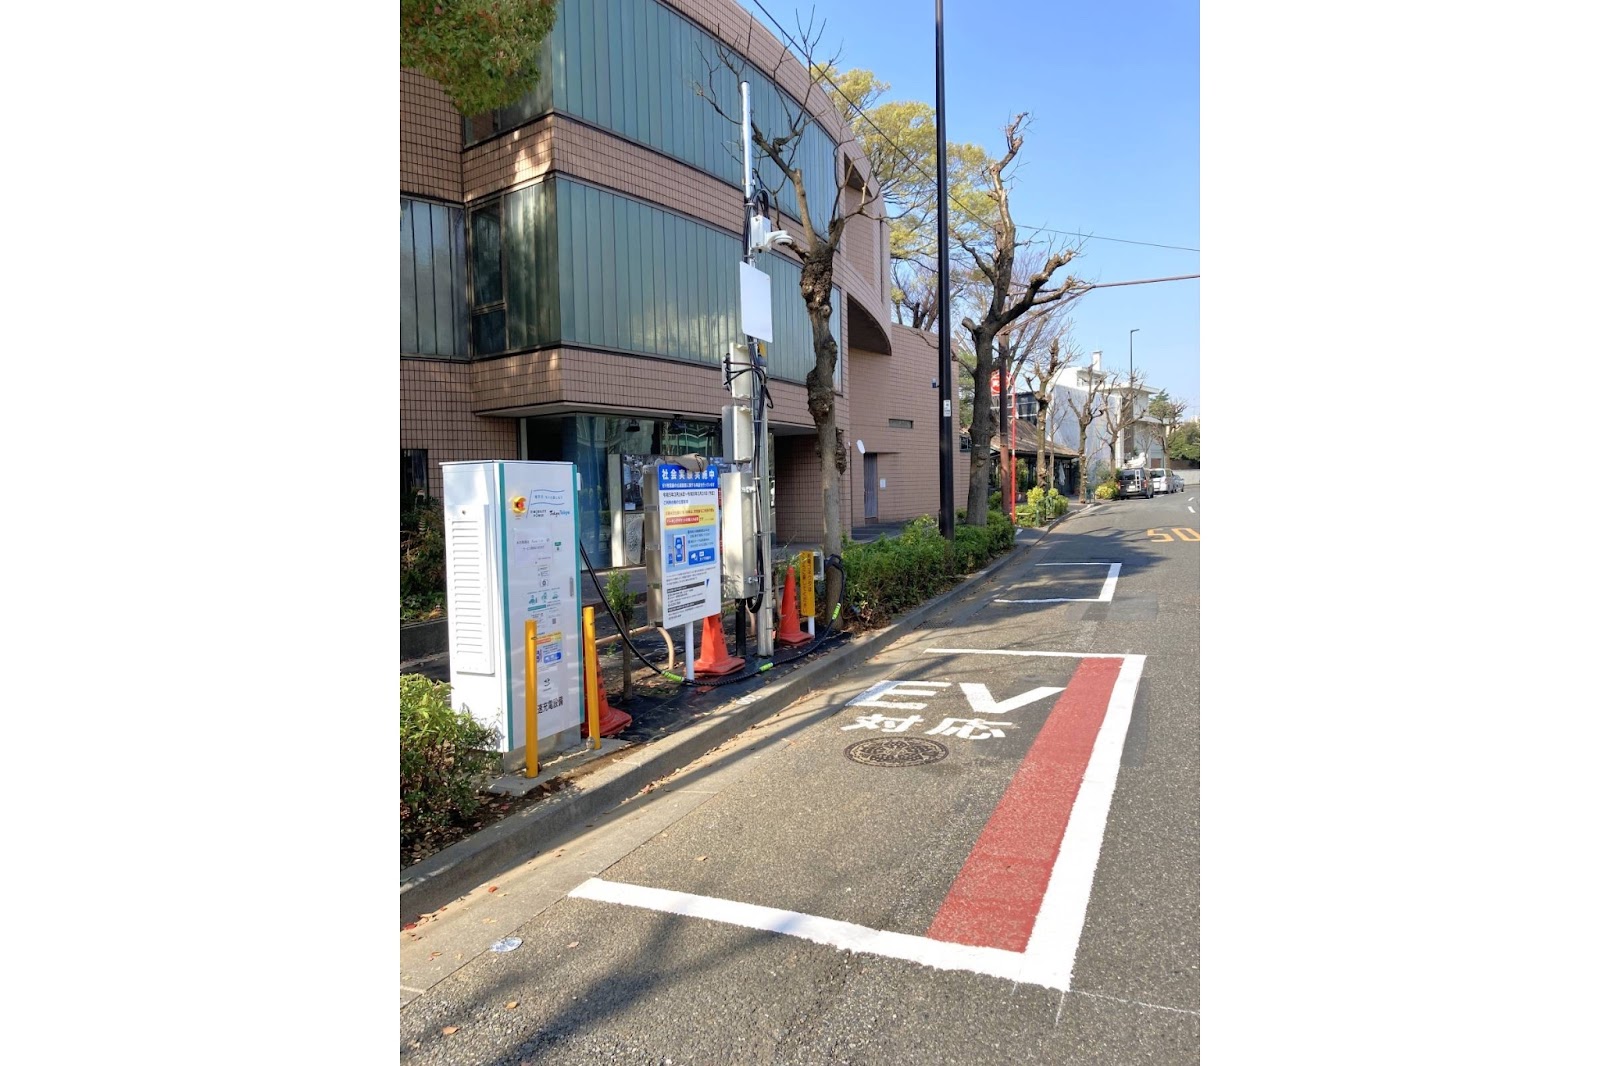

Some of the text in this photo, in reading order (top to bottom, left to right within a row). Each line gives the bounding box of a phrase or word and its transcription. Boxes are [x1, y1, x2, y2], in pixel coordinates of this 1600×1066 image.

[1147, 527, 1200, 542] 50
[845, 680, 1067, 714] EV
[841, 713, 1013, 740] 対応
